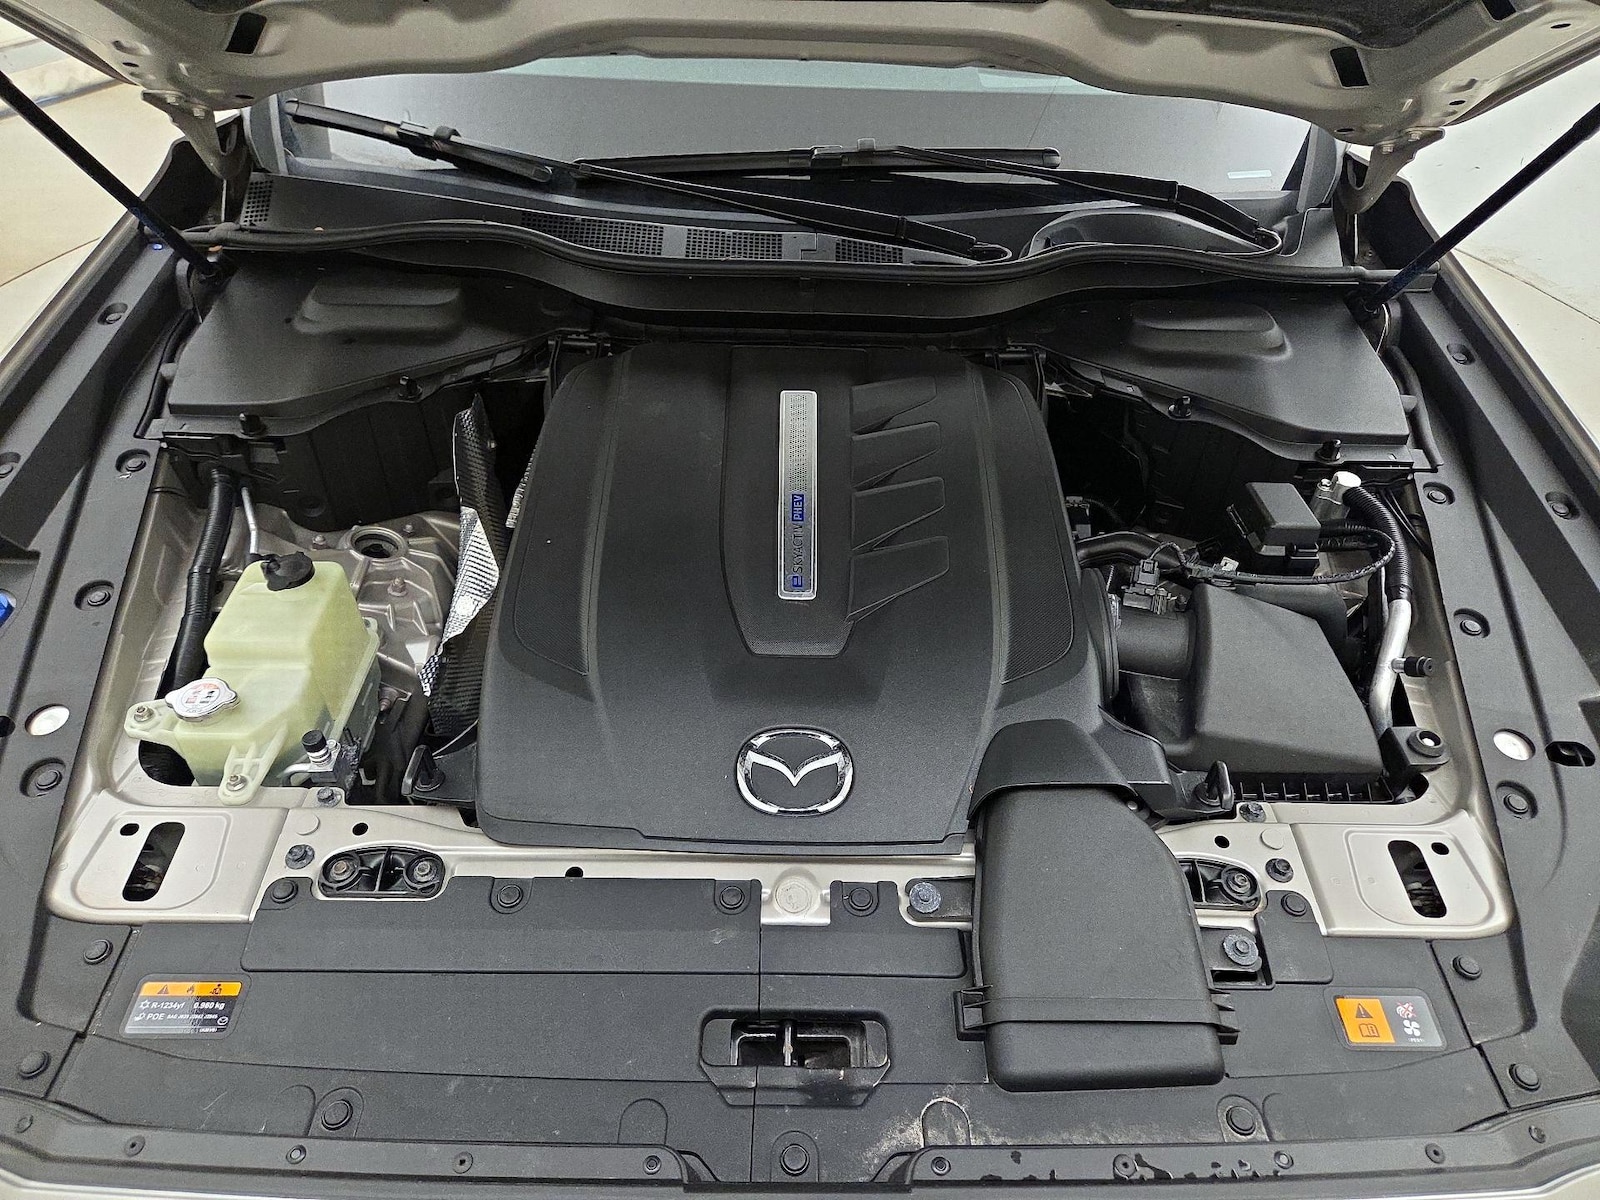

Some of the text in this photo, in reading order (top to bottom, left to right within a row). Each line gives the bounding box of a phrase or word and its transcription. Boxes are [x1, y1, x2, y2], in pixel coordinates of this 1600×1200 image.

[793, 494, 803, 520] PHEV
[792, 523, 803, 573] SKYACTIV
[215, 1002, 225, 1010] kg
